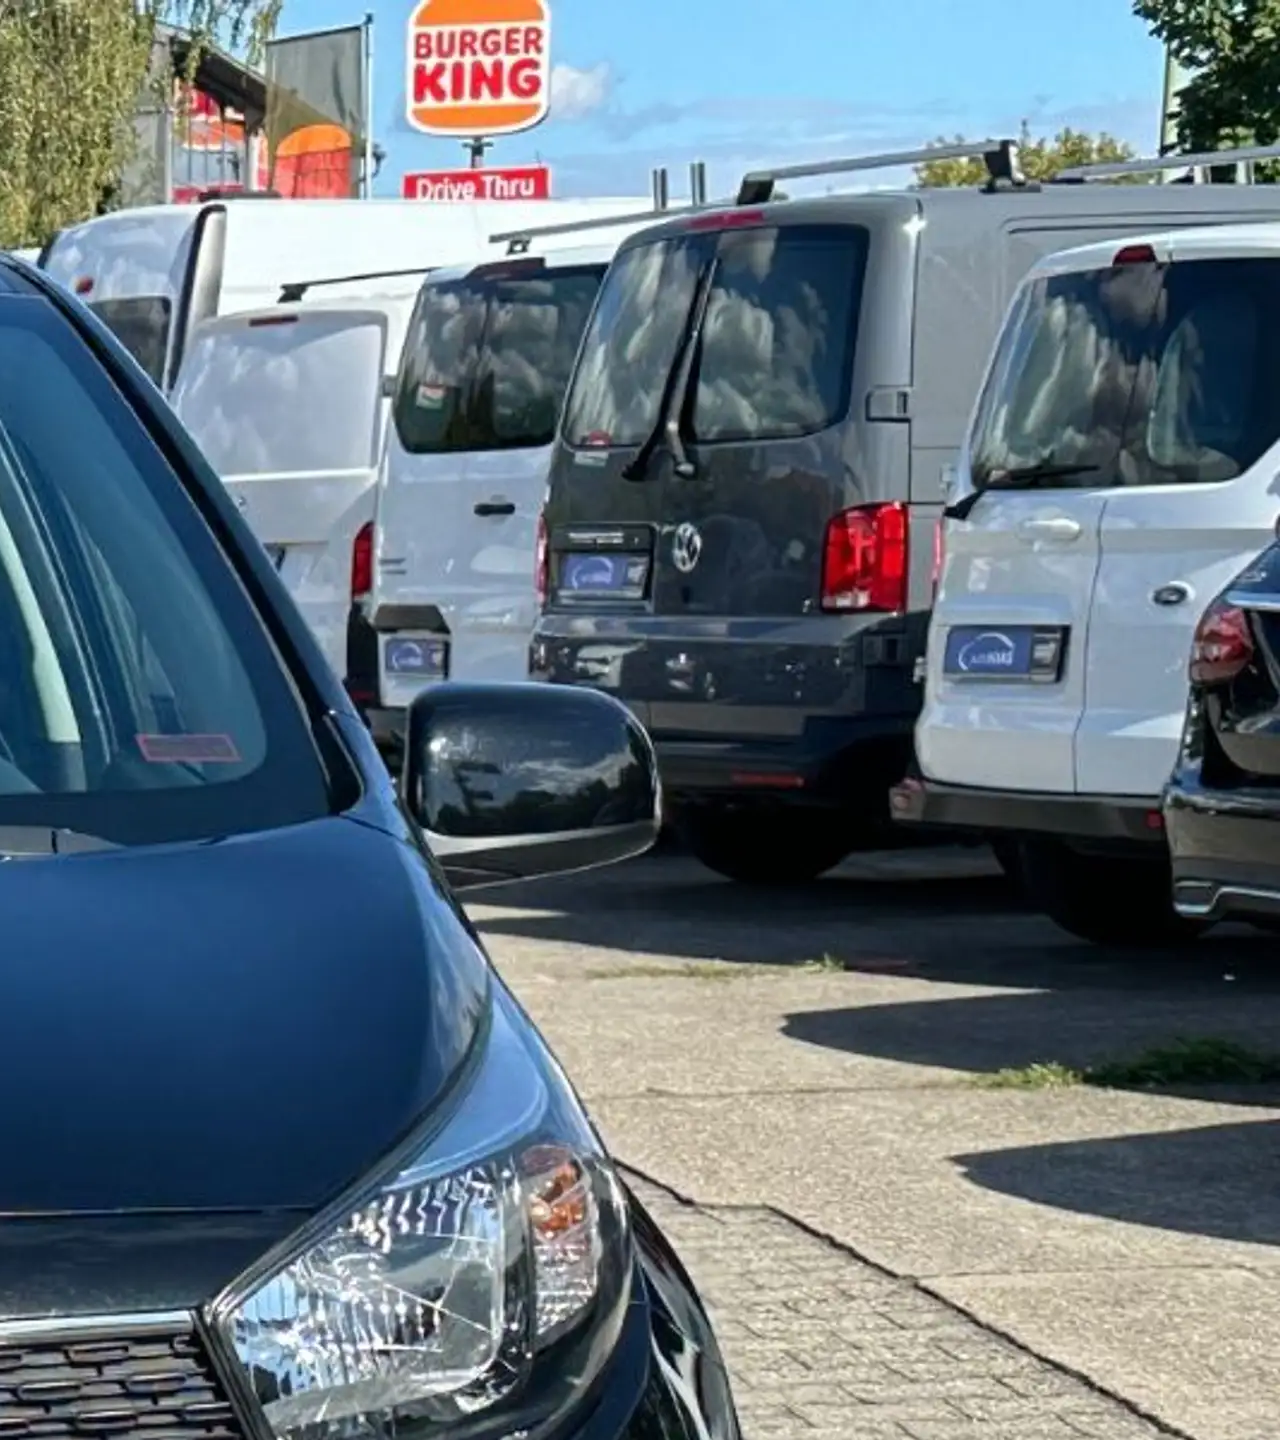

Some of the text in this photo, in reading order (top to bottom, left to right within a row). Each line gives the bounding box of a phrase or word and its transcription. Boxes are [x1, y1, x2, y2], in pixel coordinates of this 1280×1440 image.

[414, 27, 544, 60] BURGER
[413, 57, 542, 103] KING
[416, 174, 536, 199] Drive Thru
